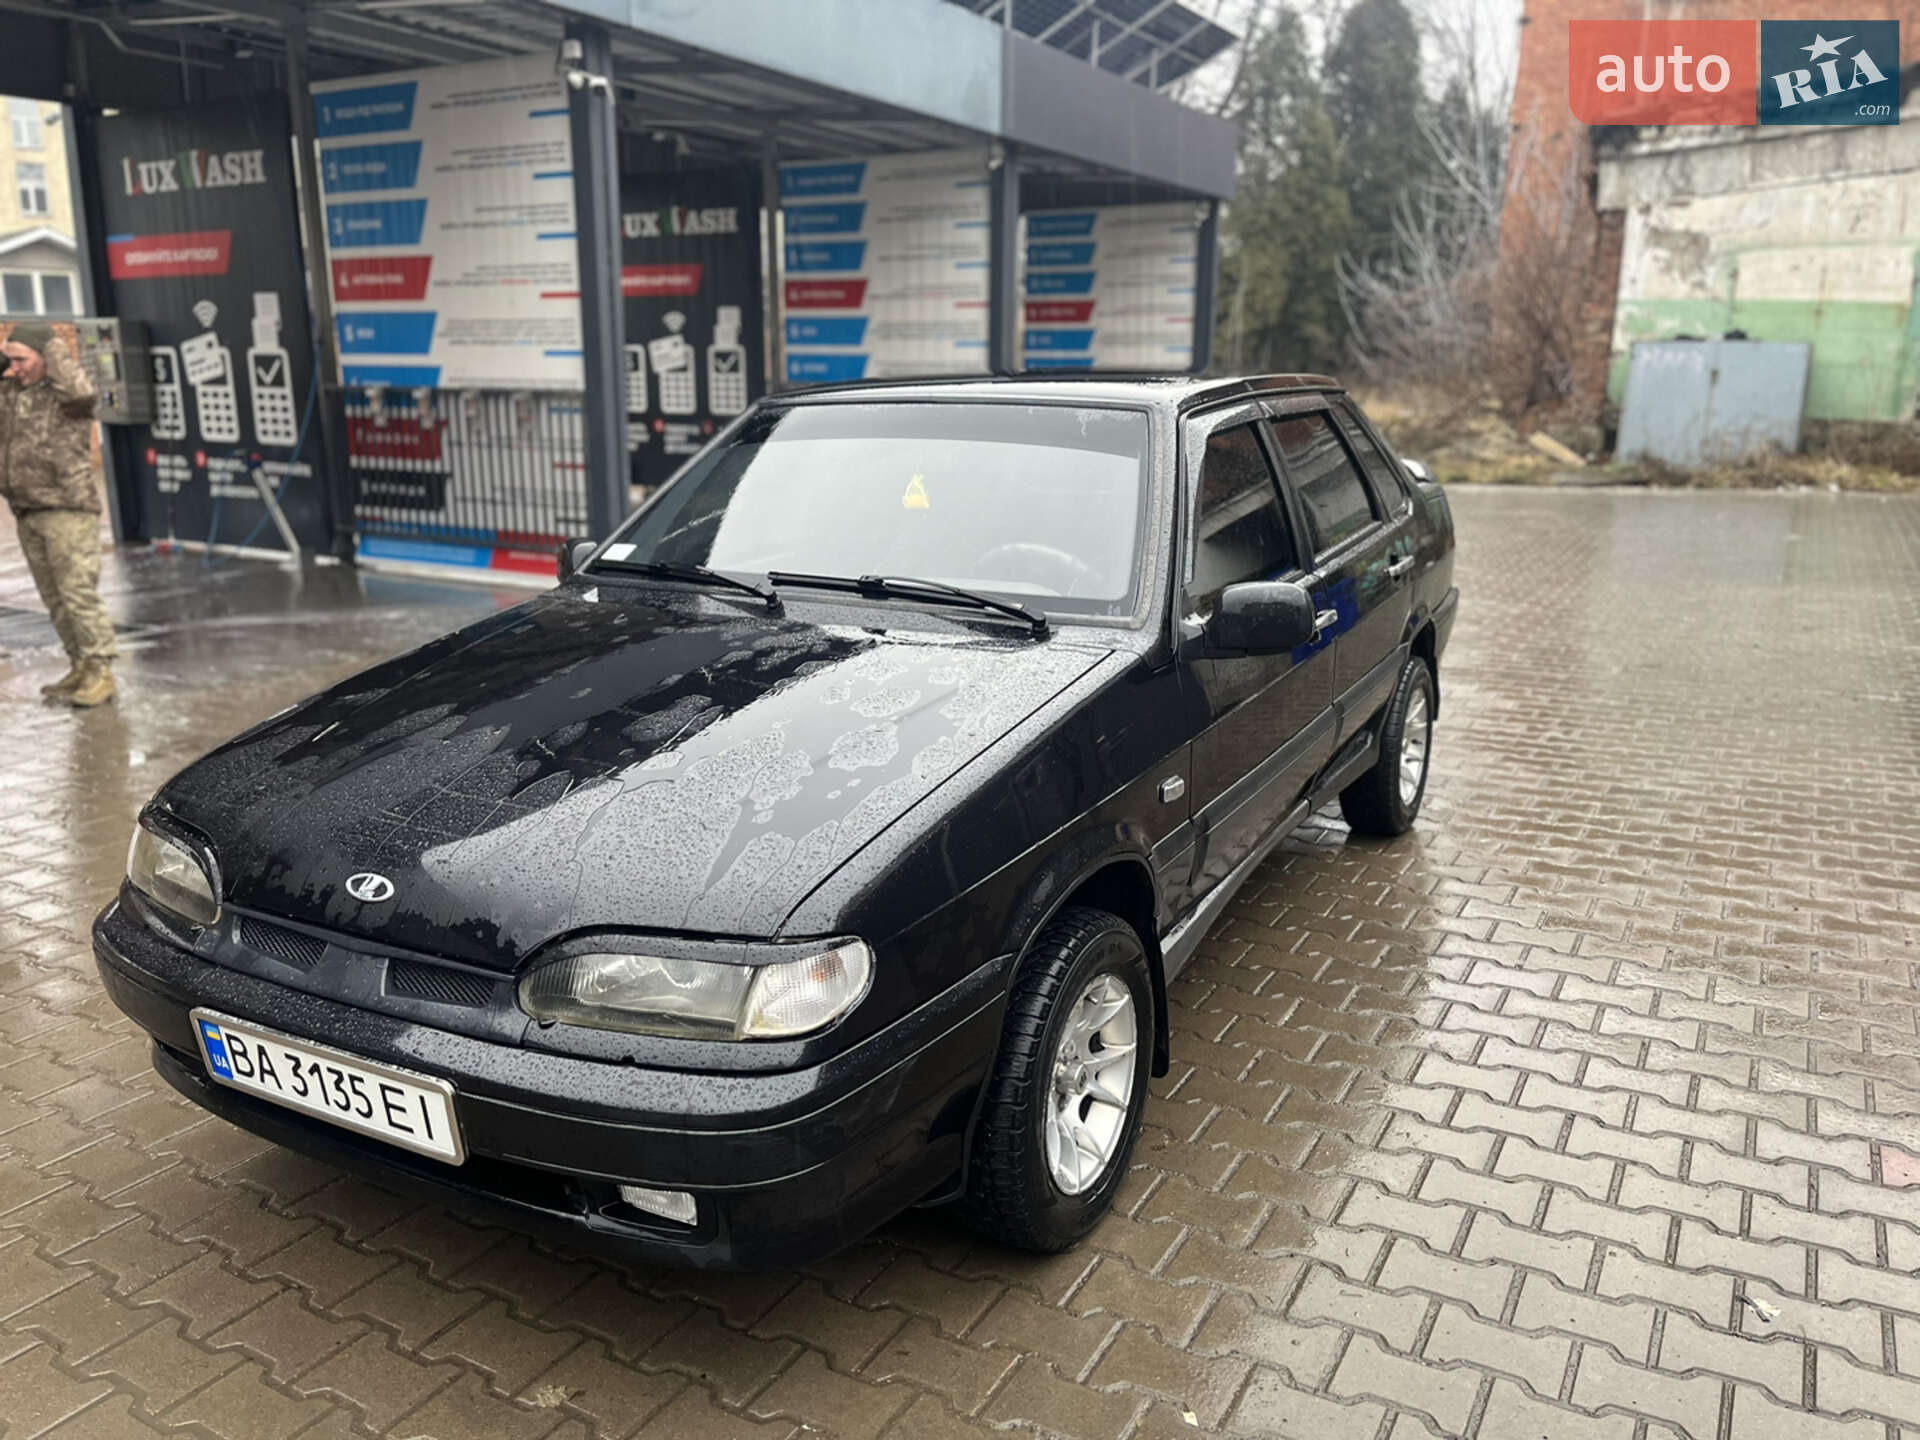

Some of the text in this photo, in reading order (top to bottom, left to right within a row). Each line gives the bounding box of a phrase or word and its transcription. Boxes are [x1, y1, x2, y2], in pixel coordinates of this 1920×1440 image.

[620, 212, 661, 239] UX
[213, 1053, 230, 1070] UA
[225, 1033, 434, 1140] BA 3135 EI
